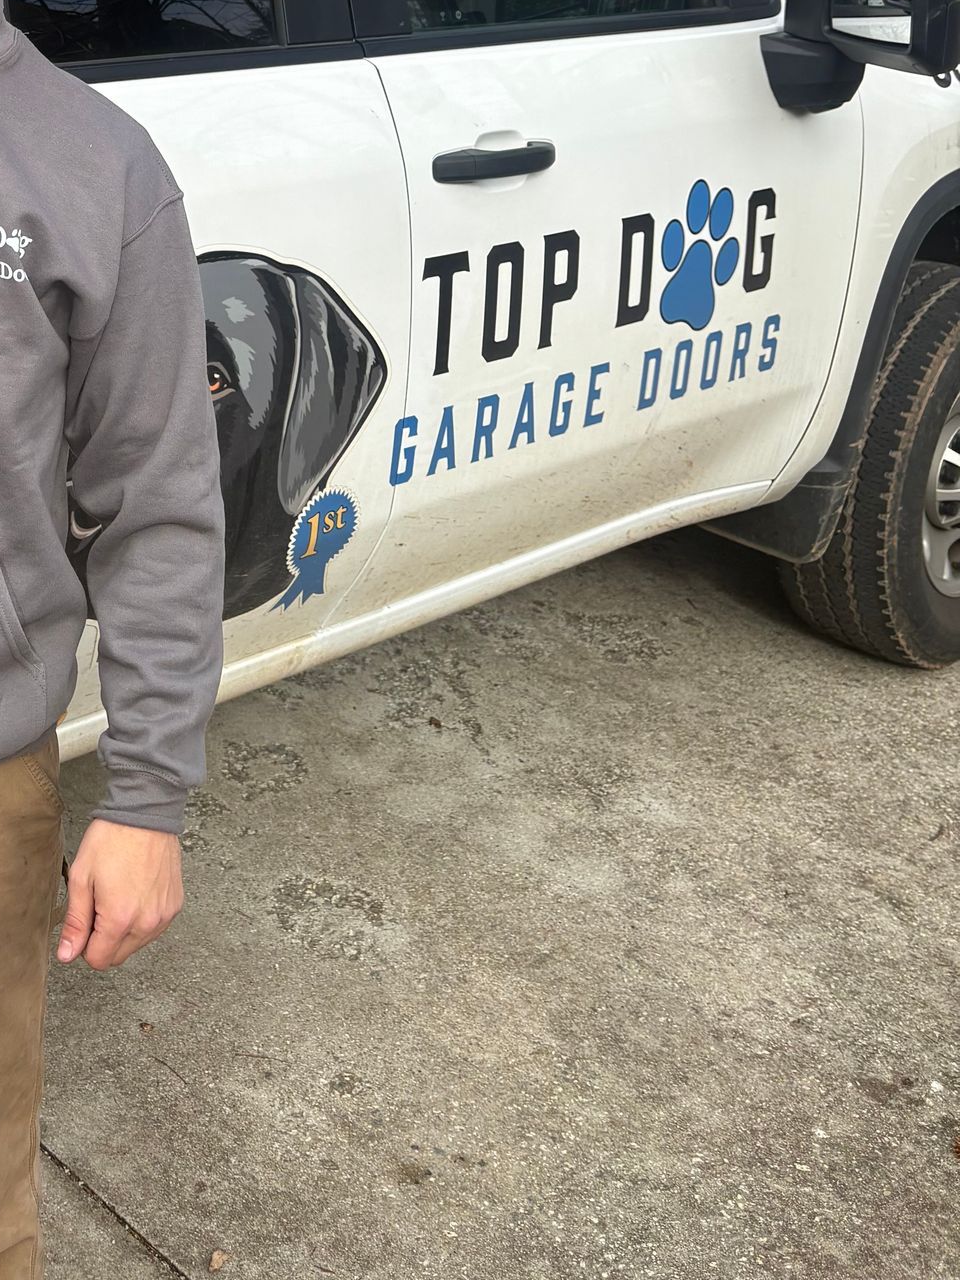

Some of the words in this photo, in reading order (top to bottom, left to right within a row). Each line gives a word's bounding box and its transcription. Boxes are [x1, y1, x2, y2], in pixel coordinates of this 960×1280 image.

[0, 261, 29, 283] Do
[422, 229, 580, 377] TOP
[388, 362, 610, 487] GARAGE
[636, 314, 781, 412] DOORS
[300, 504, 348, 560] 1st
